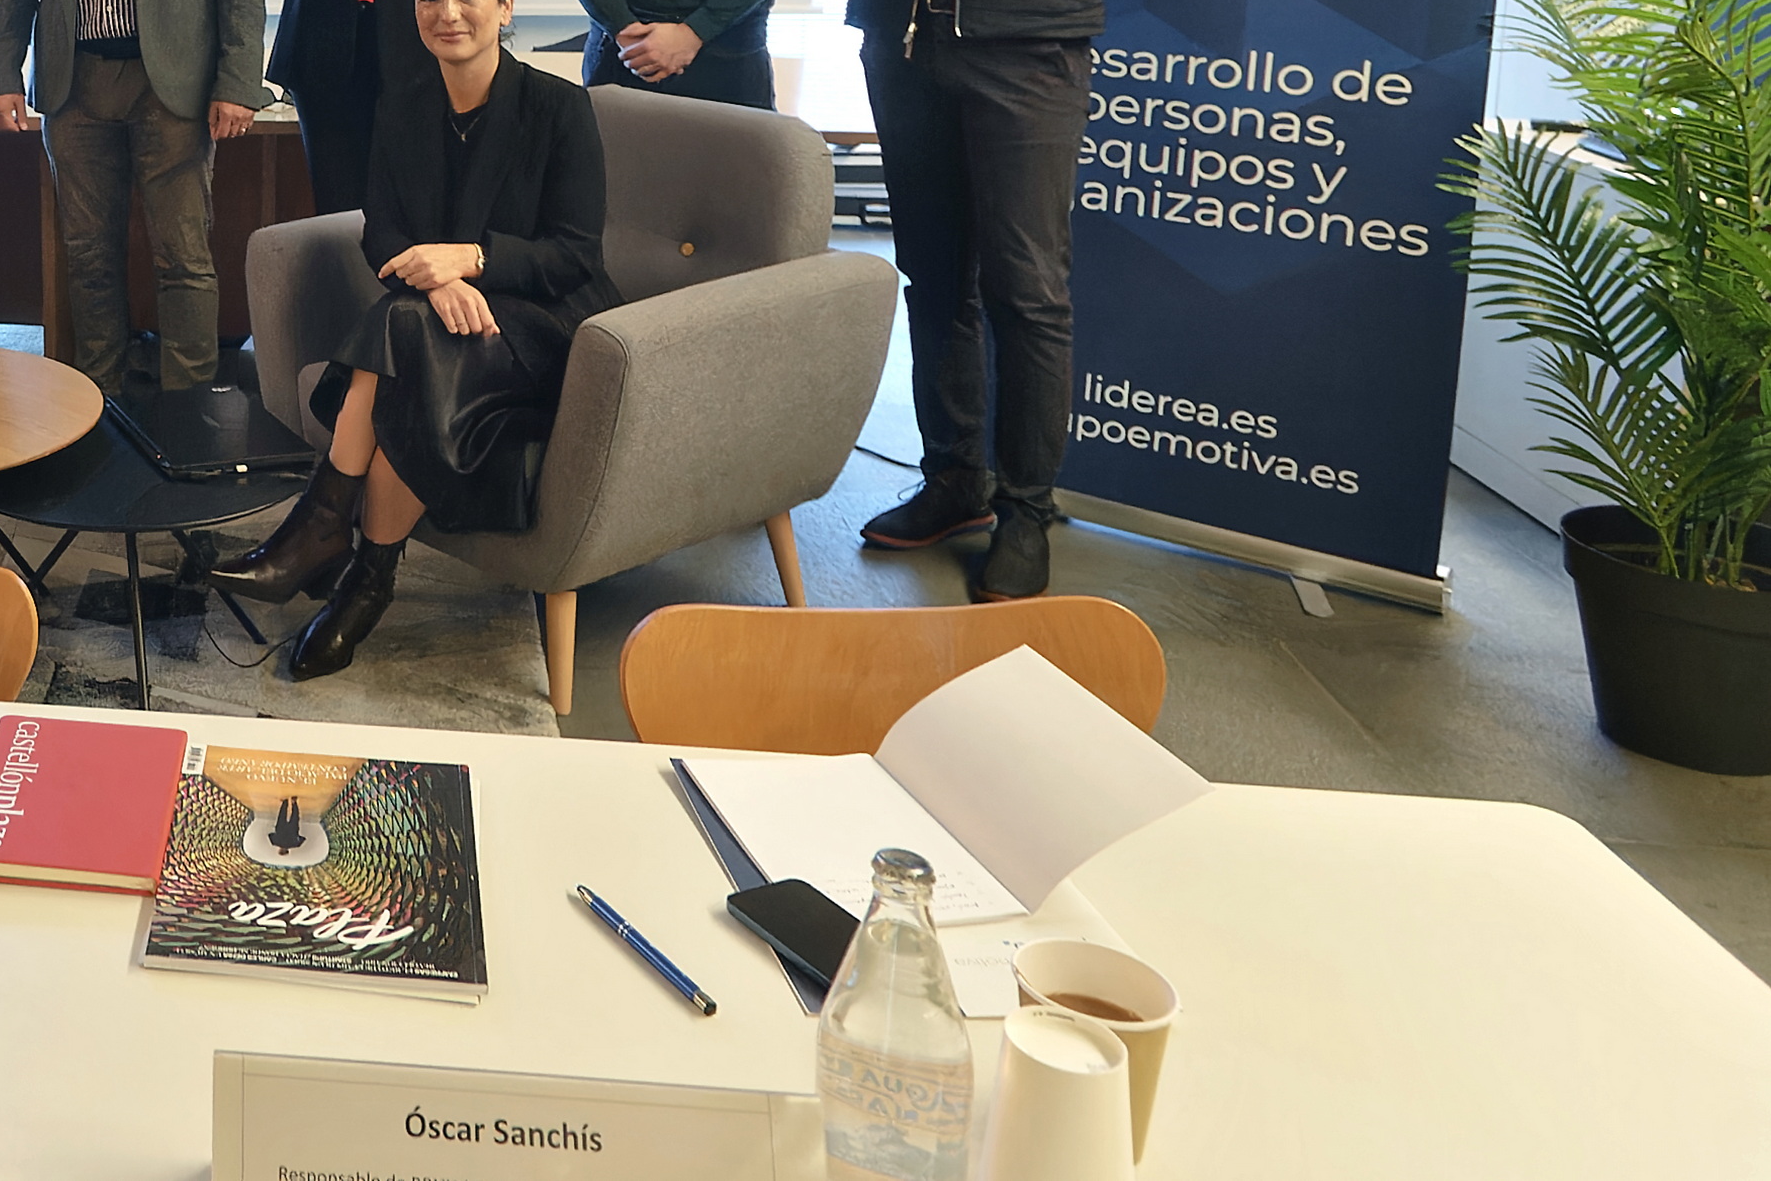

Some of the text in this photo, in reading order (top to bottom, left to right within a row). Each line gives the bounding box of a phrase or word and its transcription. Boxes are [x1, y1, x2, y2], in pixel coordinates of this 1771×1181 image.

[1090, 48, 1413, 106] sarrollo de
[1307, 163, 1347, 204] y
[1070, 180, 1429, 256] anizaciones
[1084, 373, 1278, 439] liderea.es
[1067, 413, 1359, 495] poemotiva.es
[228, 901, 414, 951] Plaza
[405, 1105, 603, 1152] Óscar Sanchís
